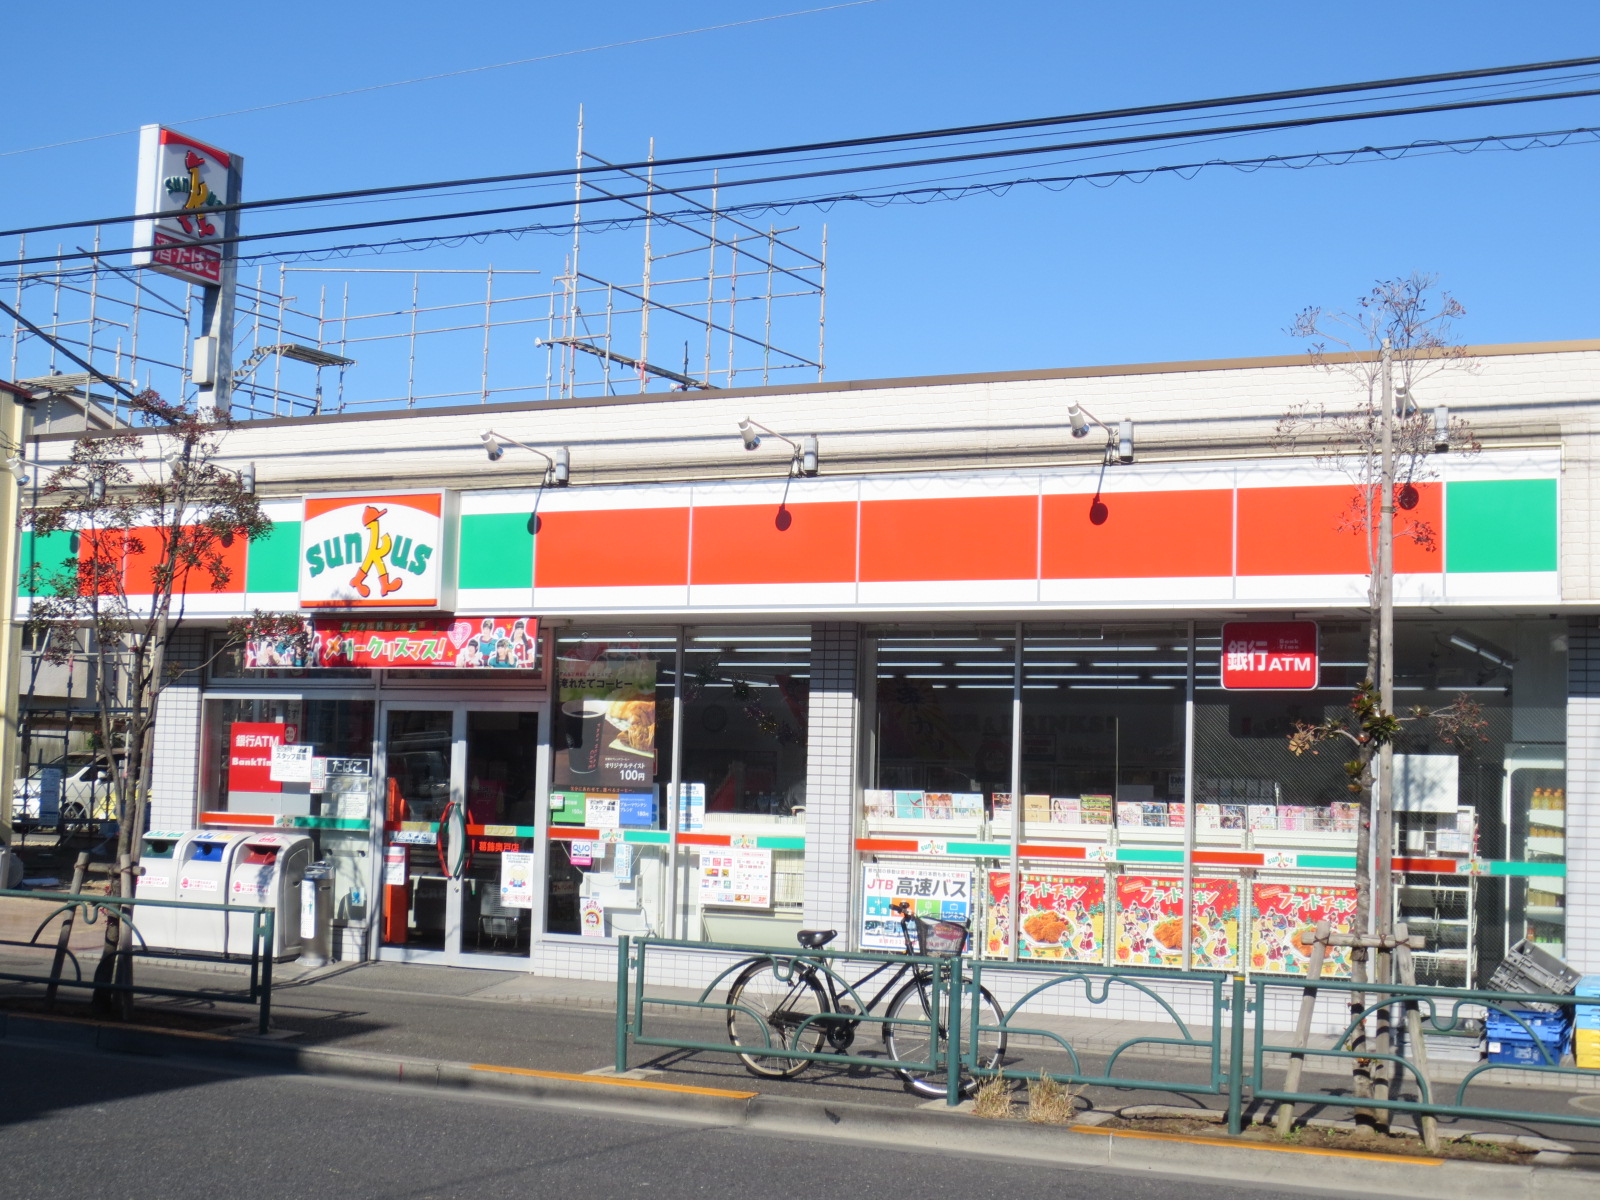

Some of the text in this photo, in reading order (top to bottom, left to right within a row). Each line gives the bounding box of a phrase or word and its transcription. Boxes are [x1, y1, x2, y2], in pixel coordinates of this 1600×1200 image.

[324, 635, 447, 662] メリークリスマス!
[1228, 641, 1311, 672] 銀行ATM
[236, 734, 280, 748] 銀行ATM
[231, 757, 272, 766] BankTi
[332, 760, 363, 773] たばこ
[619, 770, 645, 781] 100円
[573, 844, 590, 853] QUO
[867, 877, 967, 898] JTB 高速バス
[1141, 887, 1219, 905] フライドキン
